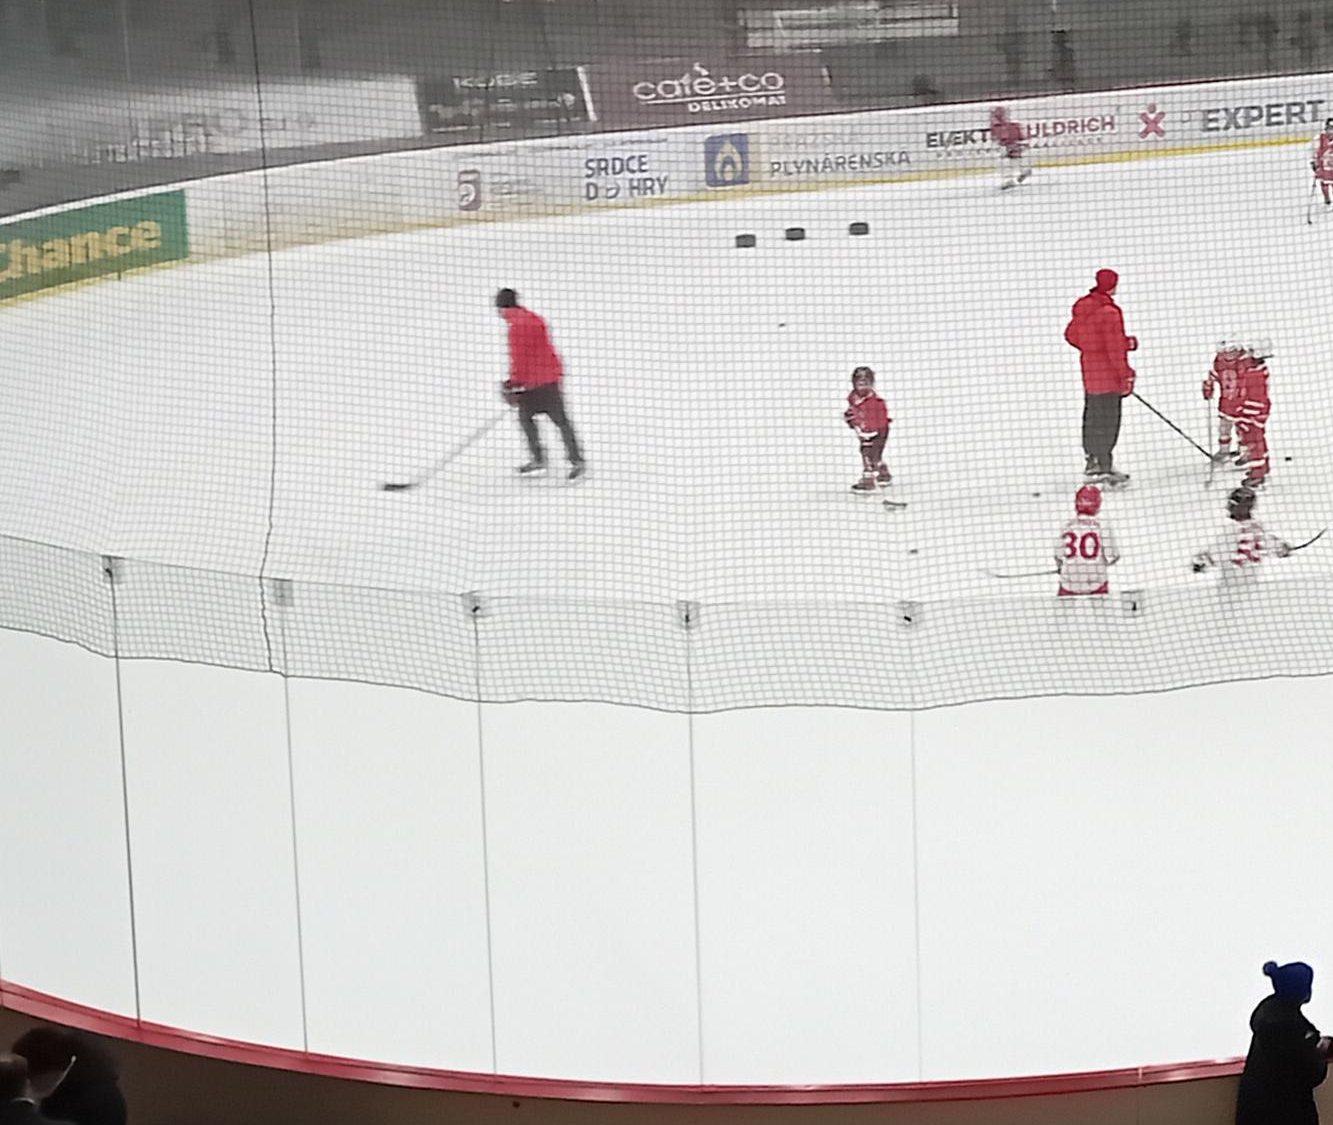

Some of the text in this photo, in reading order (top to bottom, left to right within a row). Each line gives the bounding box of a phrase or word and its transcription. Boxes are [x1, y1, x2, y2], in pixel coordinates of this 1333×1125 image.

[687, 94, 787, 113] DELIKOMAT
[1202, 99, 1326, 133] EXPERT
[926, 126, 1000, 149] ELEKT
[584, 154, 650, 178] SRDCE
[628, 176, 669, 198] HRY
[0, 220, 162, 282] hance
[1062, 531, 1101, 560] 30
